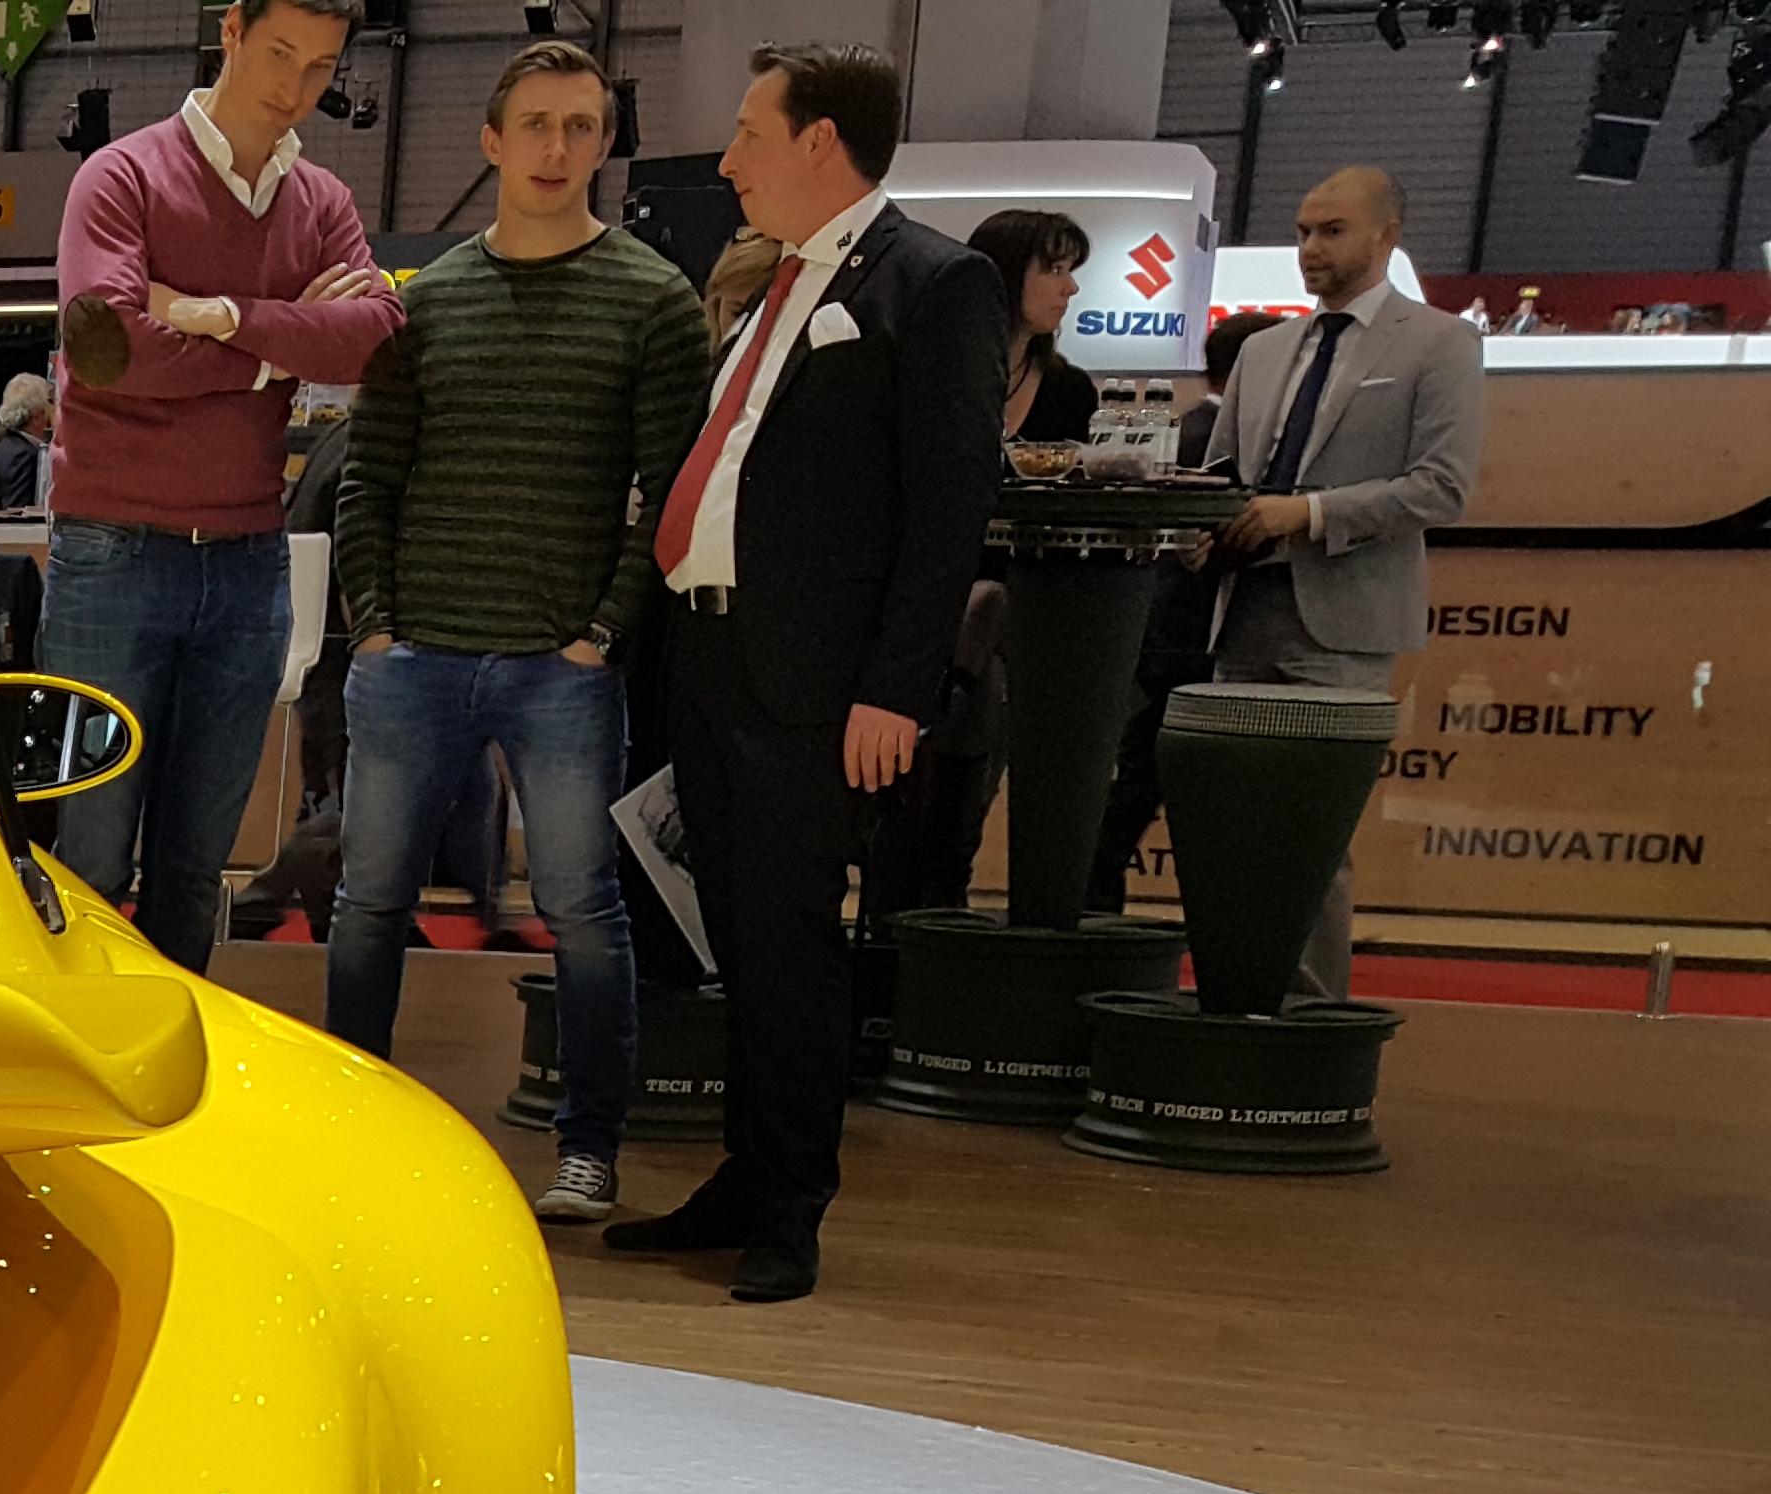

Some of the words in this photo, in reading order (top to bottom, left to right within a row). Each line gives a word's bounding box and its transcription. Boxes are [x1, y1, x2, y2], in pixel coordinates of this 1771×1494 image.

[1076, 310, 1186, 338] SUZUKI
[1439, 702, 1655, 737] MOBILITY
[1422, 825, 1705, 865] INNOVATION
[646, 1078, 693, 1093] TECH
[1153, 1101, 1224, 1122] FORGED
